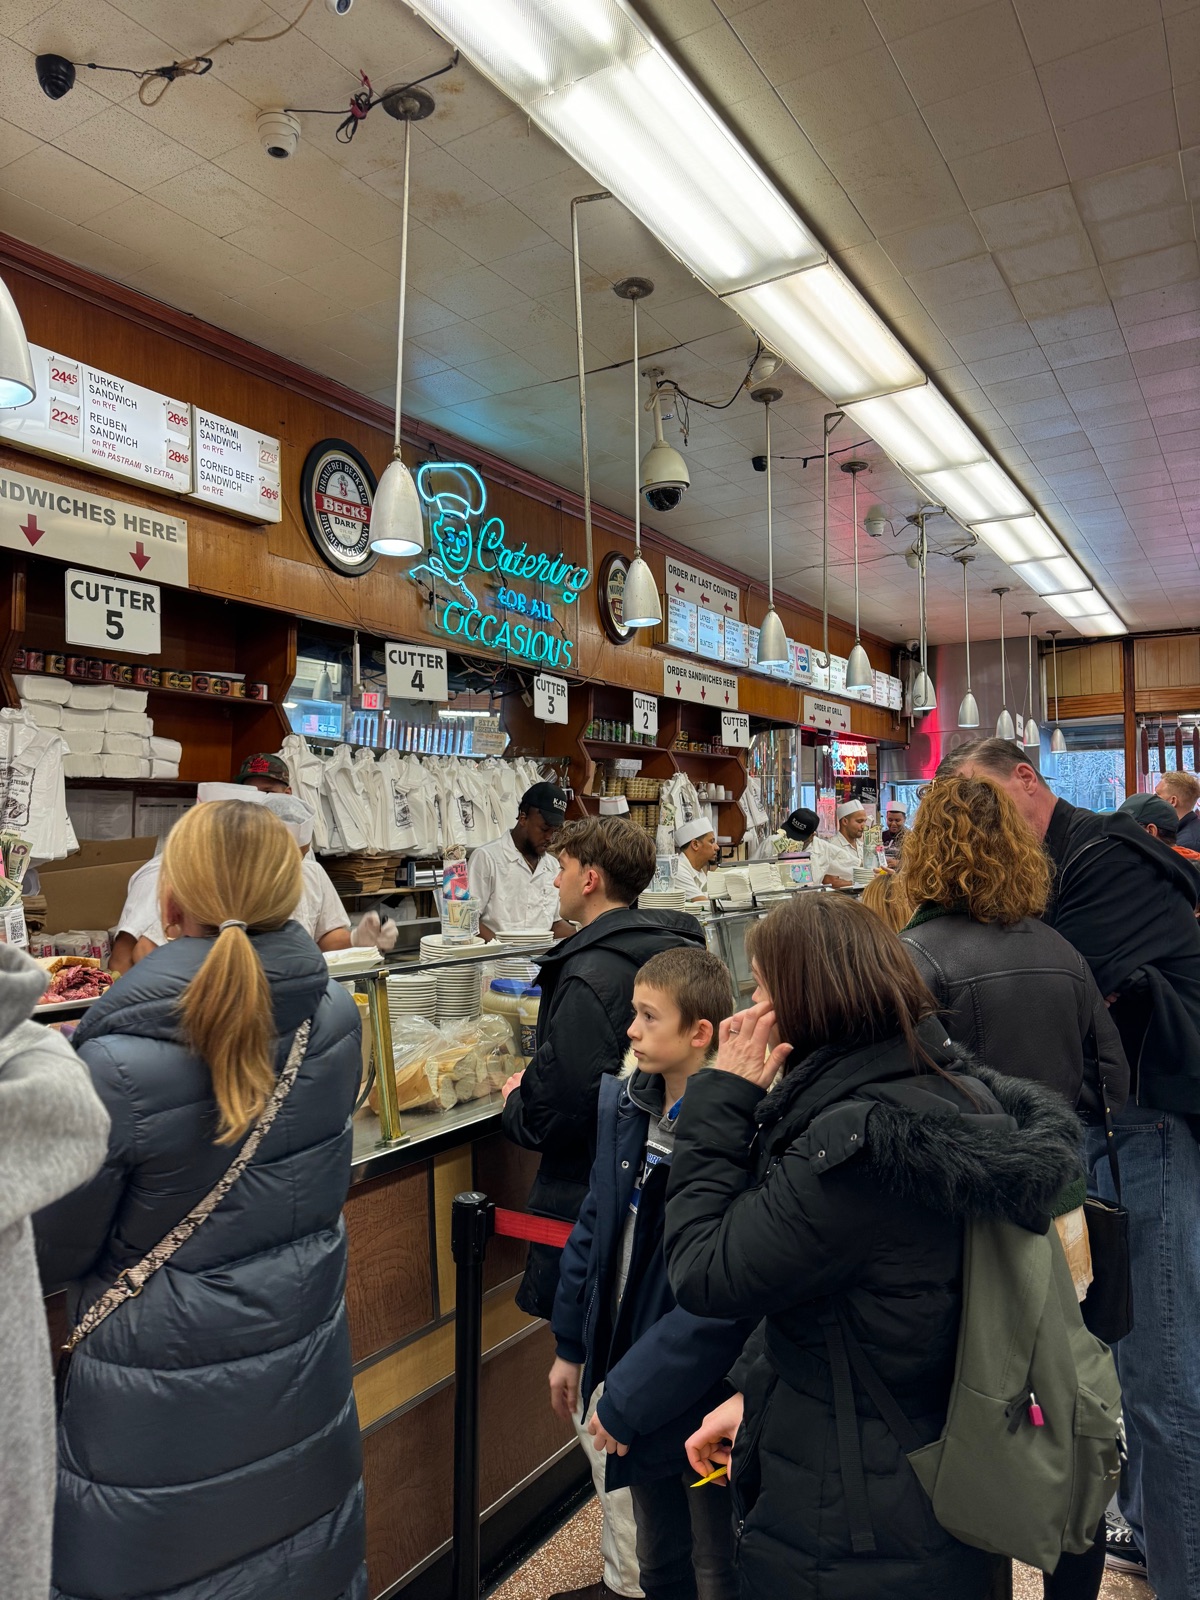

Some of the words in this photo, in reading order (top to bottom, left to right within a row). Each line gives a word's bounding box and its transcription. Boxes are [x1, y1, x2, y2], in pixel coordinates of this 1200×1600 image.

[51, 368, 78, 385] 2445
[88, 372, 124, 393] TURKEY
[88, 384, 137, 409] SANDWICH
[92, 398, 100, 406] on
[102, 400, 116, 411] RYE
[51, 408, 79, 425] 2245
[89, 412, 127, 433] REUBEN
[167, 411, 188, 426] 2645
[89, 424, 138, 448] SANDWICH
[200, 416, 239, 439] PASTRAMI
[92, 438, 100, 446] on
[102, 440, 116, 451] RYE
[200, 429, 242, 452] SANDWICH
[211, 445, 224, 456] RYE
[92, 448, 106, 458] with
[107, 453, 142, 470] PASTRAMI
[153, 467, 174, 480] EXTRA
[168, 449, 189, 464] 2845
[200, 458, 234, 477] CORNED
[235, 469, 254, 484] BEEF
[200, 470, 242, 492] SANDWICH
[319, 461, 342, 493] BRAUEREI
[211, 486, 224, 496] RYE
[260, 486, 279, 500] 2645
[321, 495, 368, 521] BECK'S
[123, 513, 177, 543] HERE
[334, 516, 357, 530] DARK
[477, 517, 589, 604] Catering
[668, 564, 689, 580] ORDER
[690, 573, 697, 584] AT
[698, 577, 712, 591] LAST
[713, 583, 738, 601] COUNTER
[70, 579, 156, 613] CUTTER
[106, 610, 124, 640] 5
[388, 649, 444, 670] CUTTER
[411, 669, 425, 692] 4
[667, 665, 687, 678] ORDER
[688, 670, 722, 686] SANDWICHES
[723, 678, 736, 689] HERE
[536, 678, 566, 698] CUTTER
[547, 696, 555, 714] 3
[634, 697, 656, 713] CUTTER
[814, 702, 826, 713] ORDER
[826, 706, 831, 714] AT
[832, 707, 842, 716] GRILL
[643, 711, 649, 729] 2
[722, 716, 748, 728] CUTTER
[733, 728, 739, 742] 1
